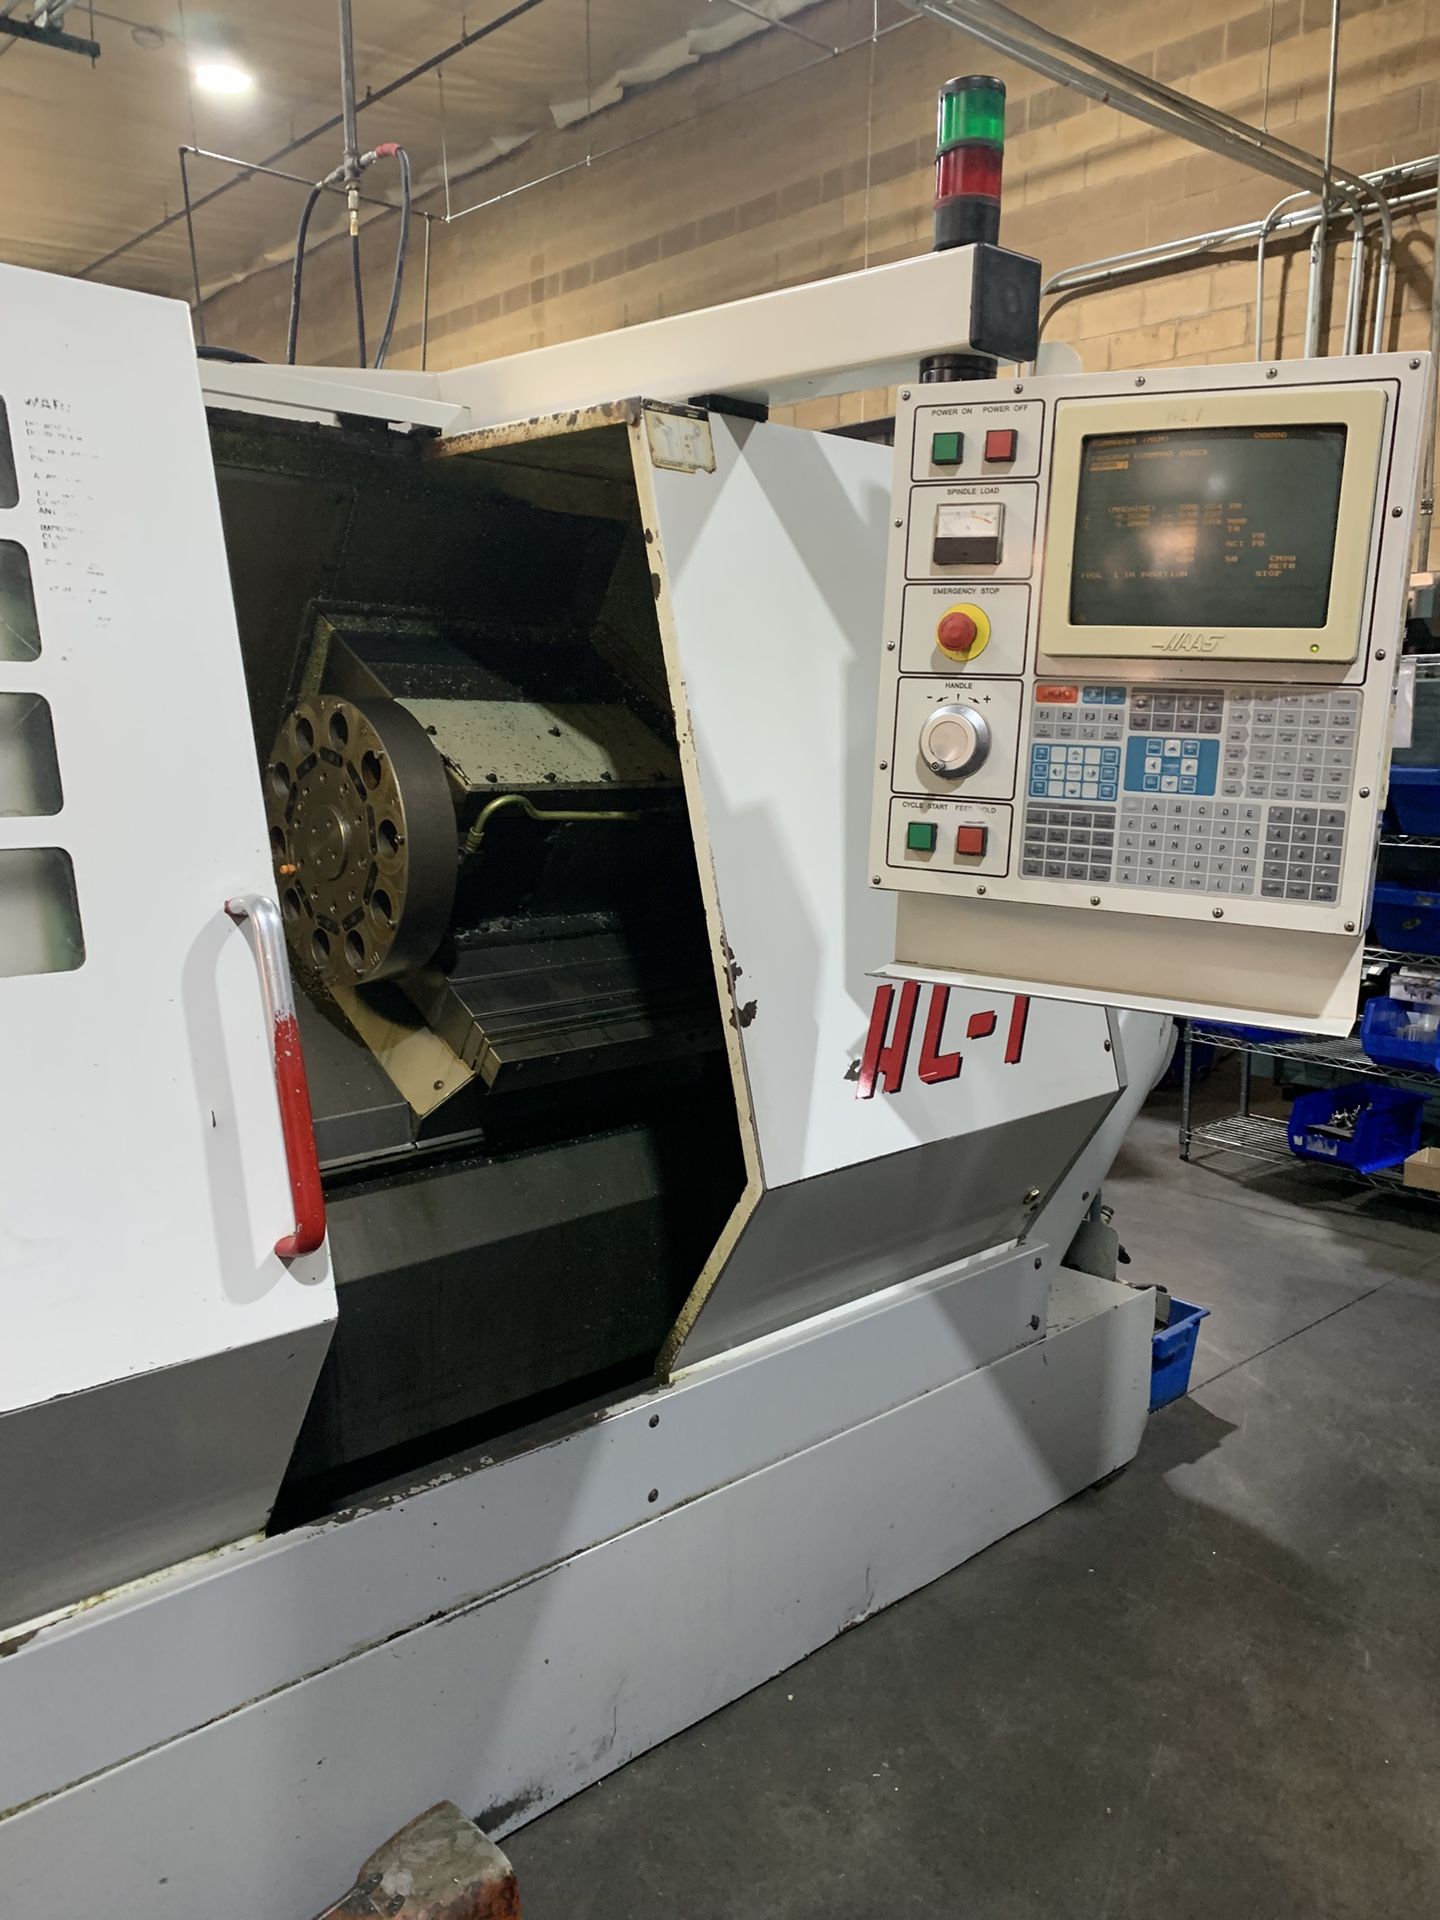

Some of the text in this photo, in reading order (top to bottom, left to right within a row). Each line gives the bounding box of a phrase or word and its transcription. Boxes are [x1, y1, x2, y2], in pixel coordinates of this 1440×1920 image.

[961, 407, 973, 415] ON
[982, 404, 1029, 414] POWER OFF
[981, 587, 1000, 595] STOP
[945, 682, 973, 690] HANDLE
[1039, 711, 1119, 721] F1 F2 F3 F4
[902, 801, 923, 809] CYCLE
[977, 806, 997, 814] OLD
[855, 979, 1030, 1100] HL-1
